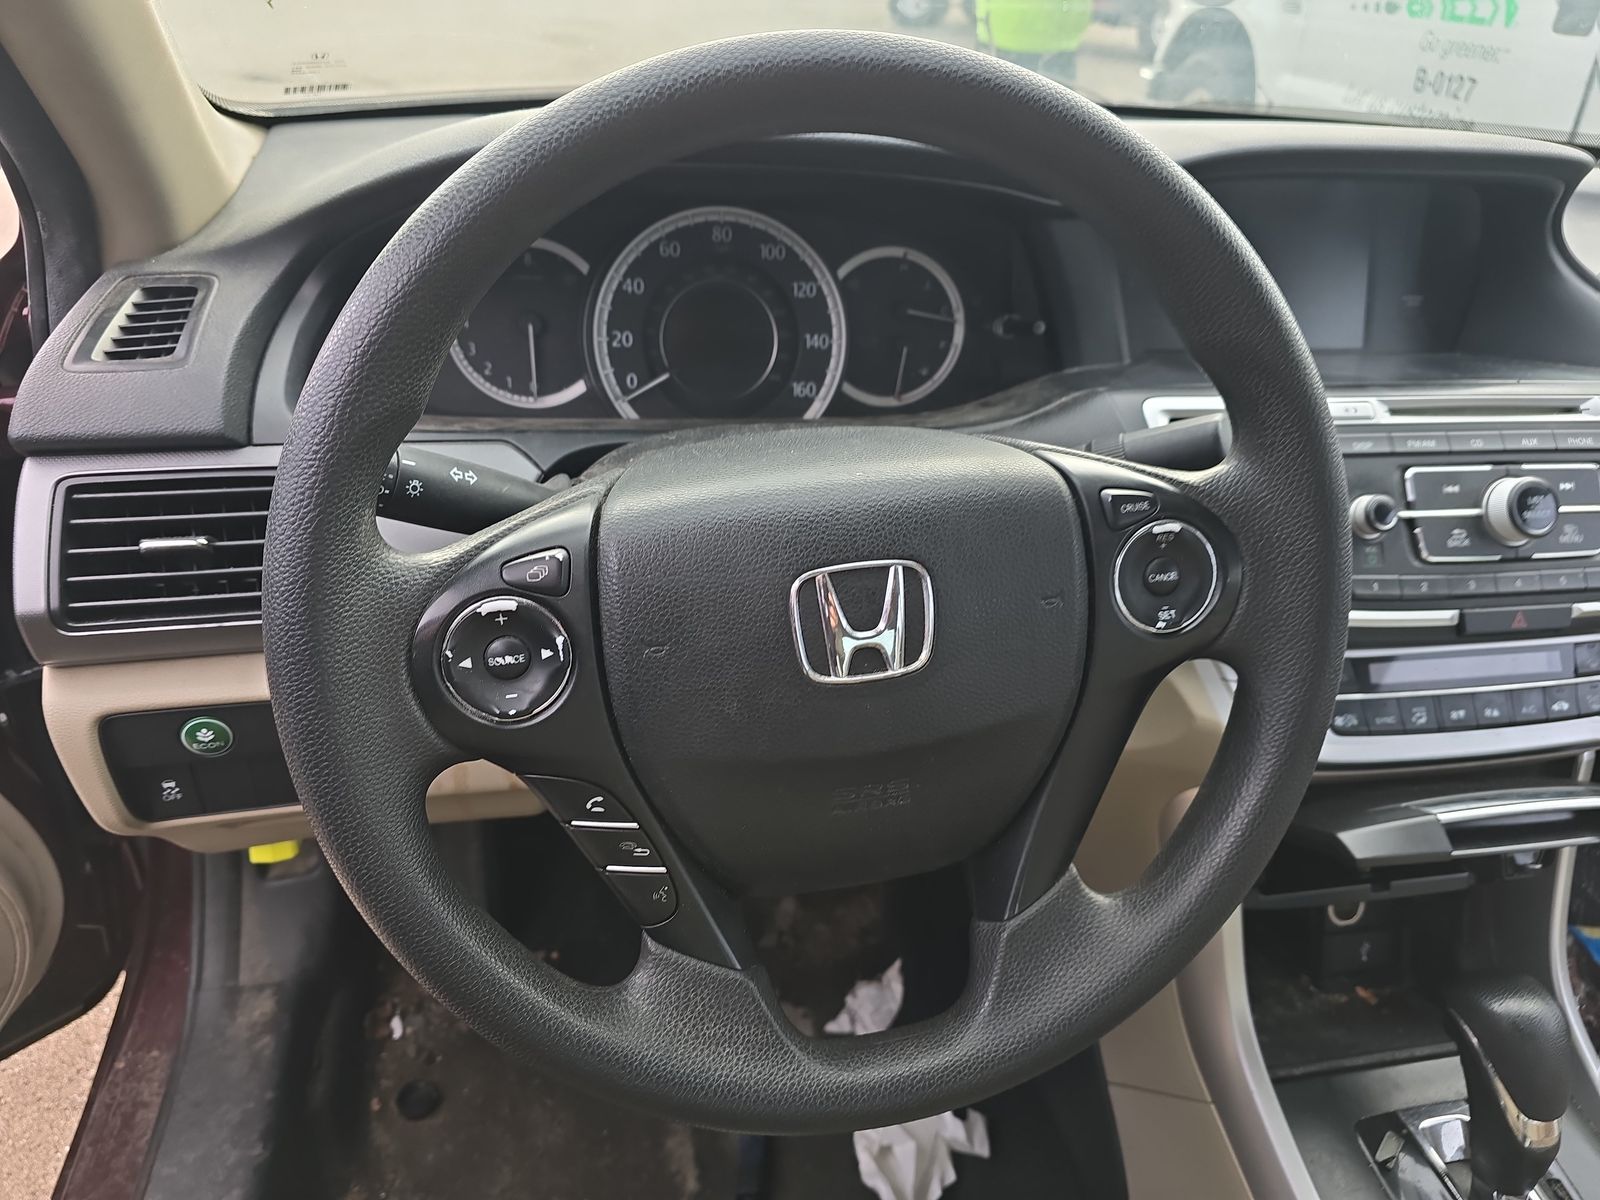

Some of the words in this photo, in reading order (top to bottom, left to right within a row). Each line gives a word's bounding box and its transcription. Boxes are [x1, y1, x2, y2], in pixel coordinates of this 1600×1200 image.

[1413, 65, 1478, 103] B-0127
[711, 226, 733, 243] 80
[659, 240, 681, 258] 60
[760, 243, 786, 261] 100
[622, 277, 645, 295] 40
[793, 281, 817, 298] 120
[611, 330, 633, 348] 20
[805, 332, 829, 350] 140
[468, 341, 476, 356] 3
[484, 361, 493, 376] 2
[506, 375, 513, 389] 1
[626, 372, 638, 389] 0
[792, 382, 817, 399] 160
[1120, 500, 1151, 514] CRUISE
[487, 653, 526, 667] SOURCE
